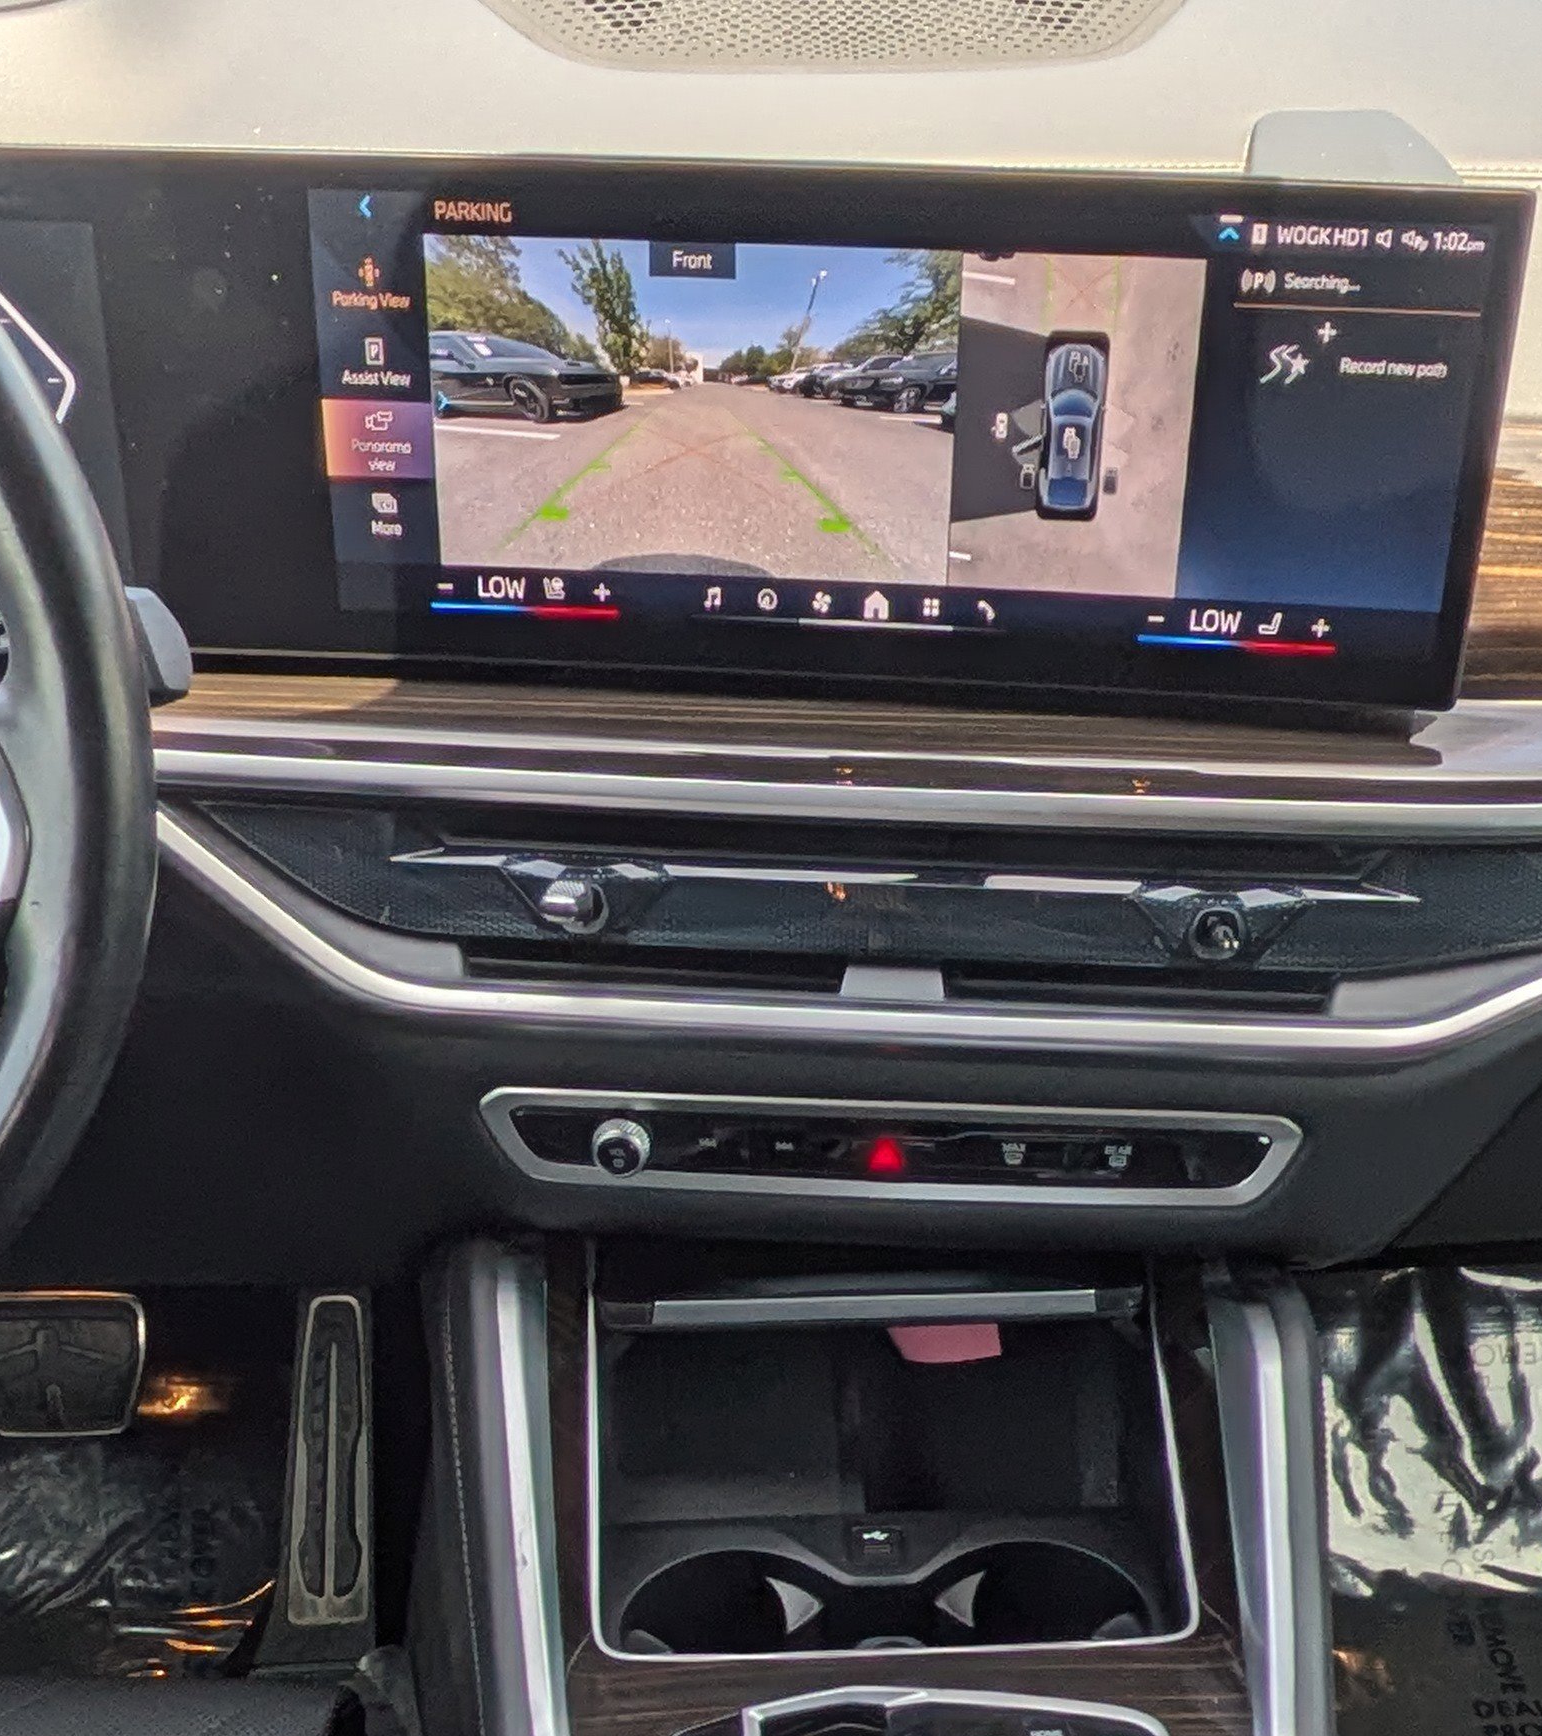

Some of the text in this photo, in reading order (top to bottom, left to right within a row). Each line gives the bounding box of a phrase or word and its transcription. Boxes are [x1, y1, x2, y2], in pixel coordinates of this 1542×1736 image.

[434, 201, 513, 223] PARKING
[1276, 225, 1332, 246] WOGK
[1333, 227, 1371, 248] HD1
[671, 249, 713, 270] Front
[331, 290, 411, 310] Parking View
[1338, 356, 1388, 376] Record
[1388, 361, 1415, 377] new
[341, 369, 412, 389] Assist View
[350, 438, 412, 454] Panorama
[371, 520, 403, 537] More
[477, 575, 527, 601] LOW
[1188, 607, 1243, 636] LOW
